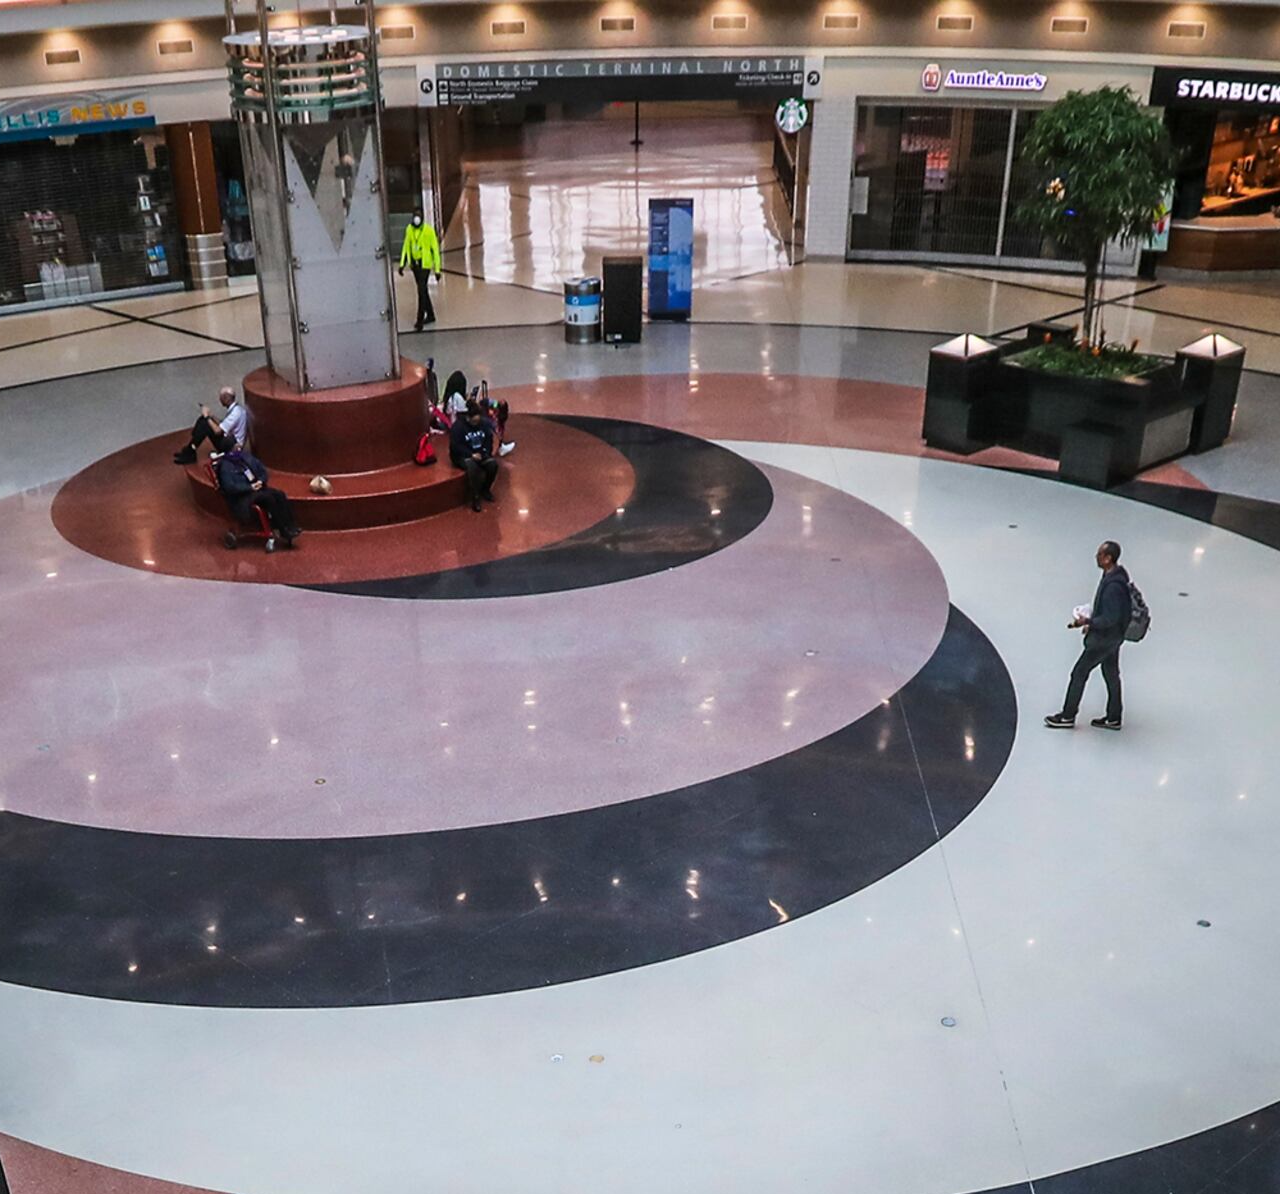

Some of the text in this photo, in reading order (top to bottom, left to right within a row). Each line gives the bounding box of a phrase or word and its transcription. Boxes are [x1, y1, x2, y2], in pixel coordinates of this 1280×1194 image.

[443, 59, 799, 78] DOMESTIC TERMINAL NORTH
[71, 100, 147, 122] NEWS
